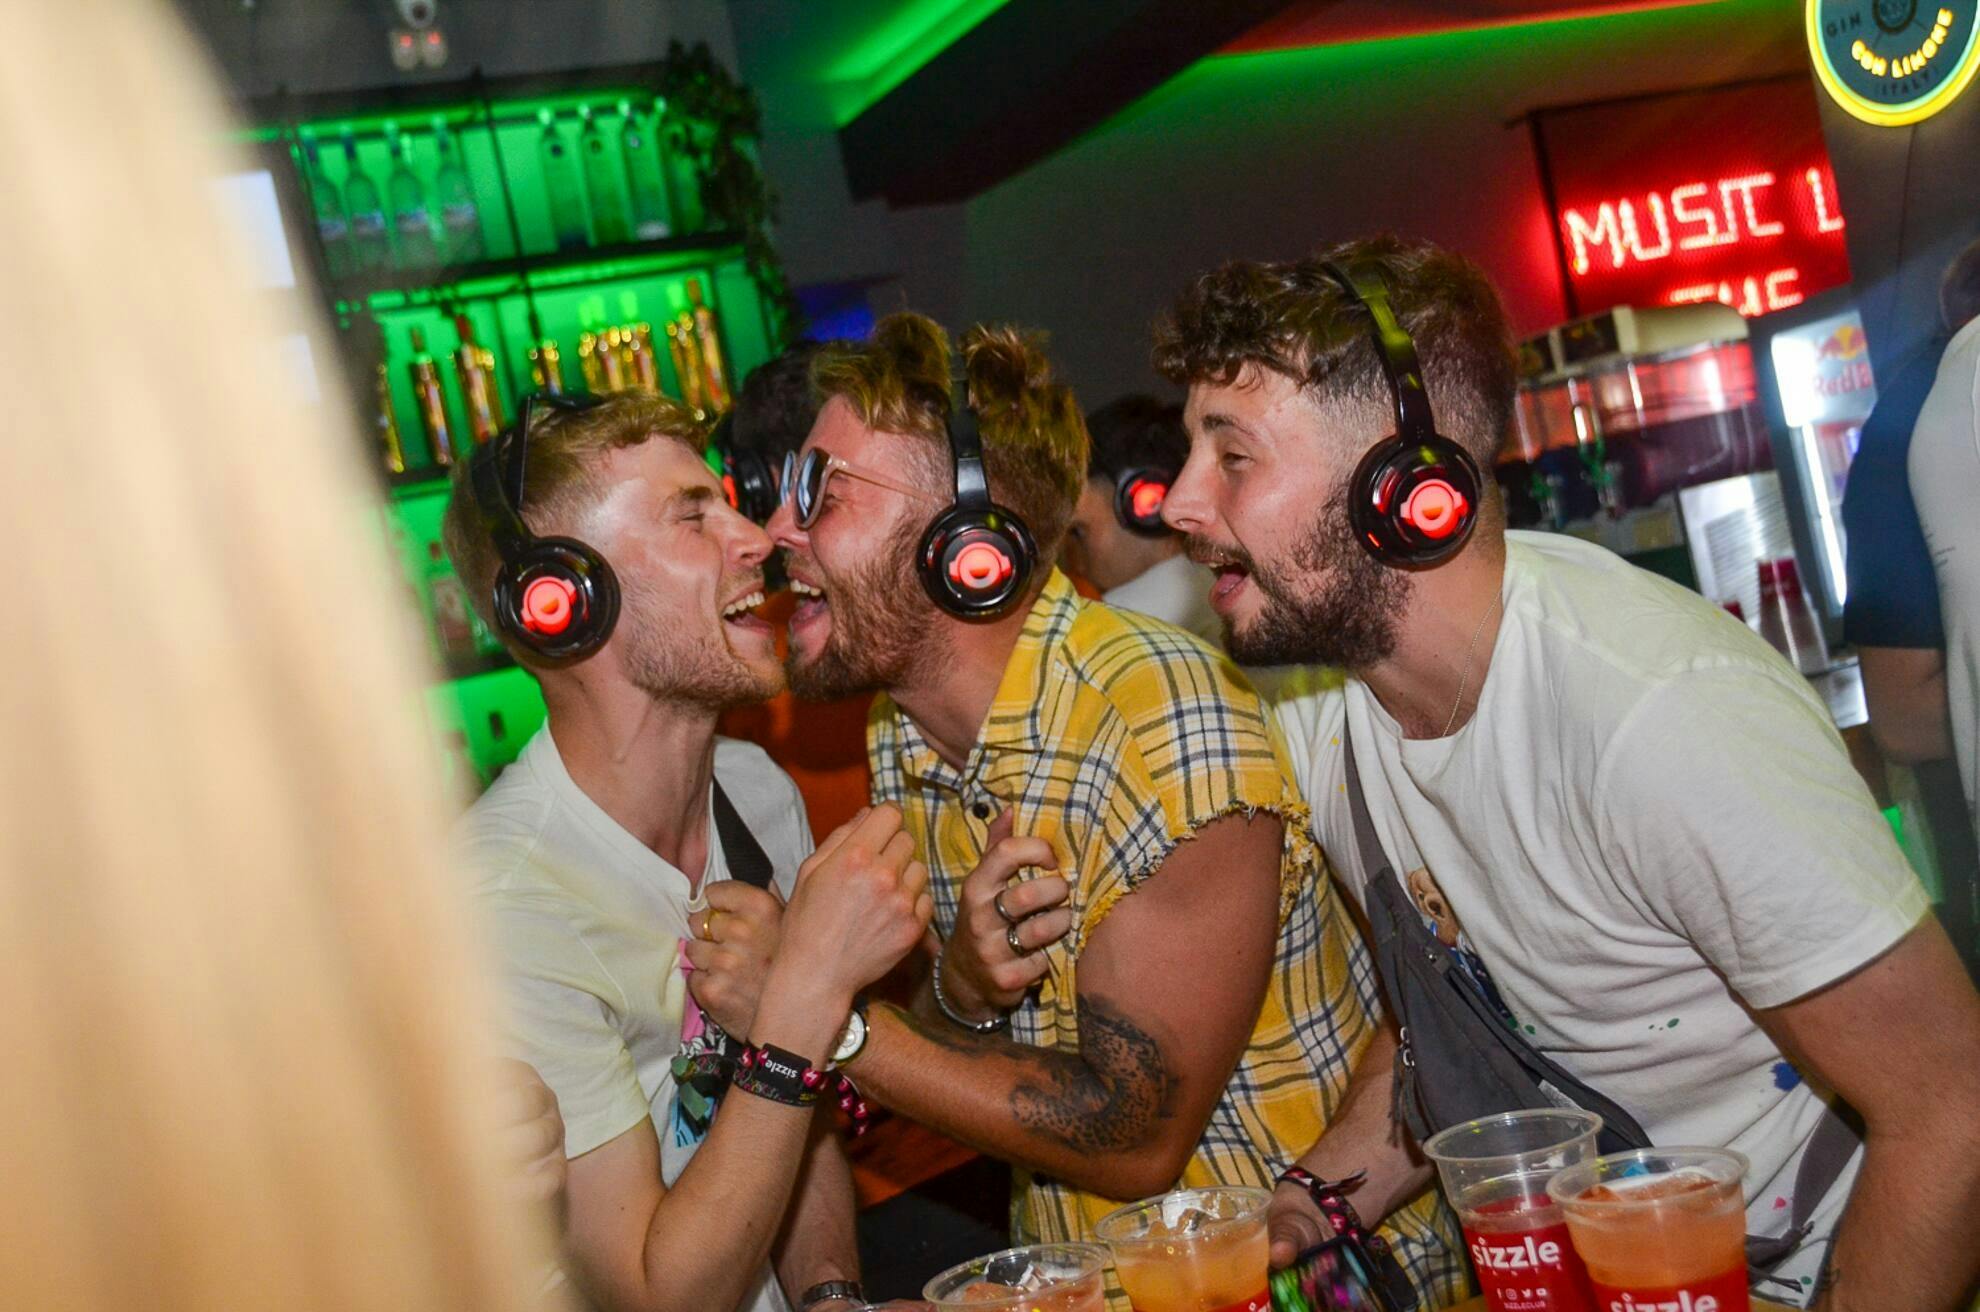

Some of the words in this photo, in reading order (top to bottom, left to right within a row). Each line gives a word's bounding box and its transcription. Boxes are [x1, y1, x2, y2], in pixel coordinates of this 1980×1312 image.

[1564, 171, 1784, 275] MUSIC
[764, 1059, 799, 1079] sizzle
[1472, 1236, 1561, 1269] sizzle
